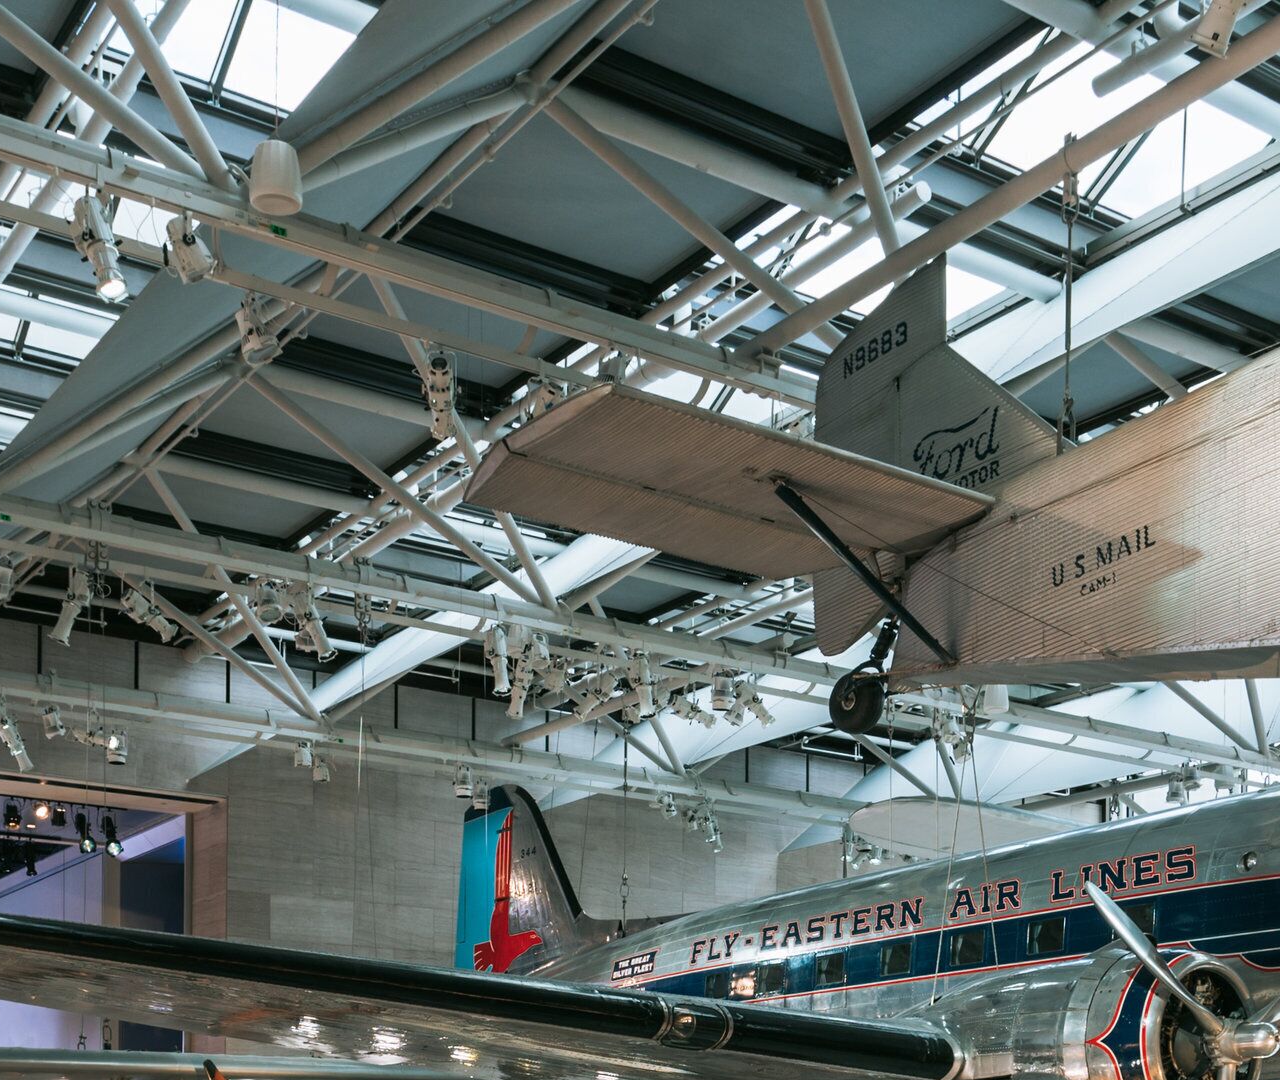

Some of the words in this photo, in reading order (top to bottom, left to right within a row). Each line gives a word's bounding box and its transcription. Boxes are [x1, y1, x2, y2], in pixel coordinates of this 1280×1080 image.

[842, 321, 908, 379] N9683
[913, 406, 1001, 481] Ford
[1096, 525, 1157, 569] MAIL
[949, 879, 1022, 921] AIR
[1049, 845, 1198, 904] LINES
